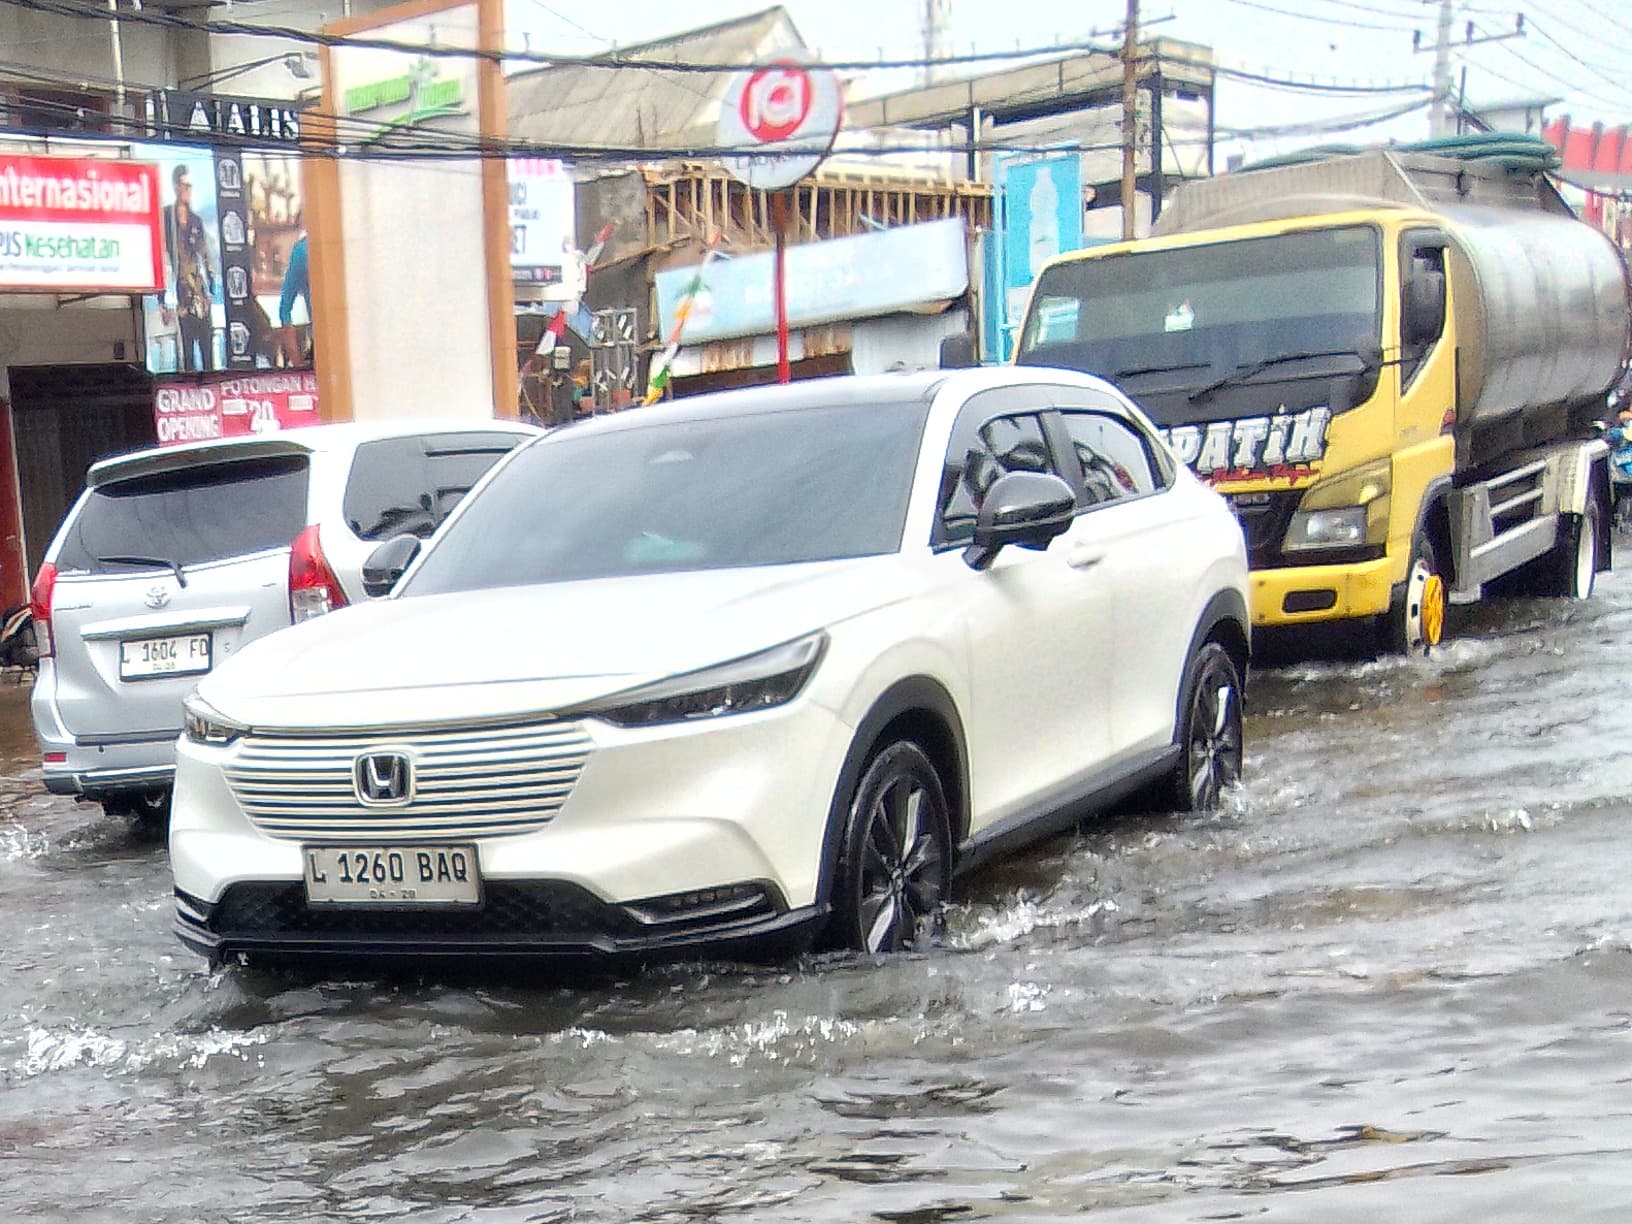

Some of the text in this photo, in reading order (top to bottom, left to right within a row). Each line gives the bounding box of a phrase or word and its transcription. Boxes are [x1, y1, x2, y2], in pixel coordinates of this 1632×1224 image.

[24, 232, 120, 259] Kesehatan
[156, 388, 216, 413] GRAND
[309, 852, 468, 884] L 1260 BAQ
